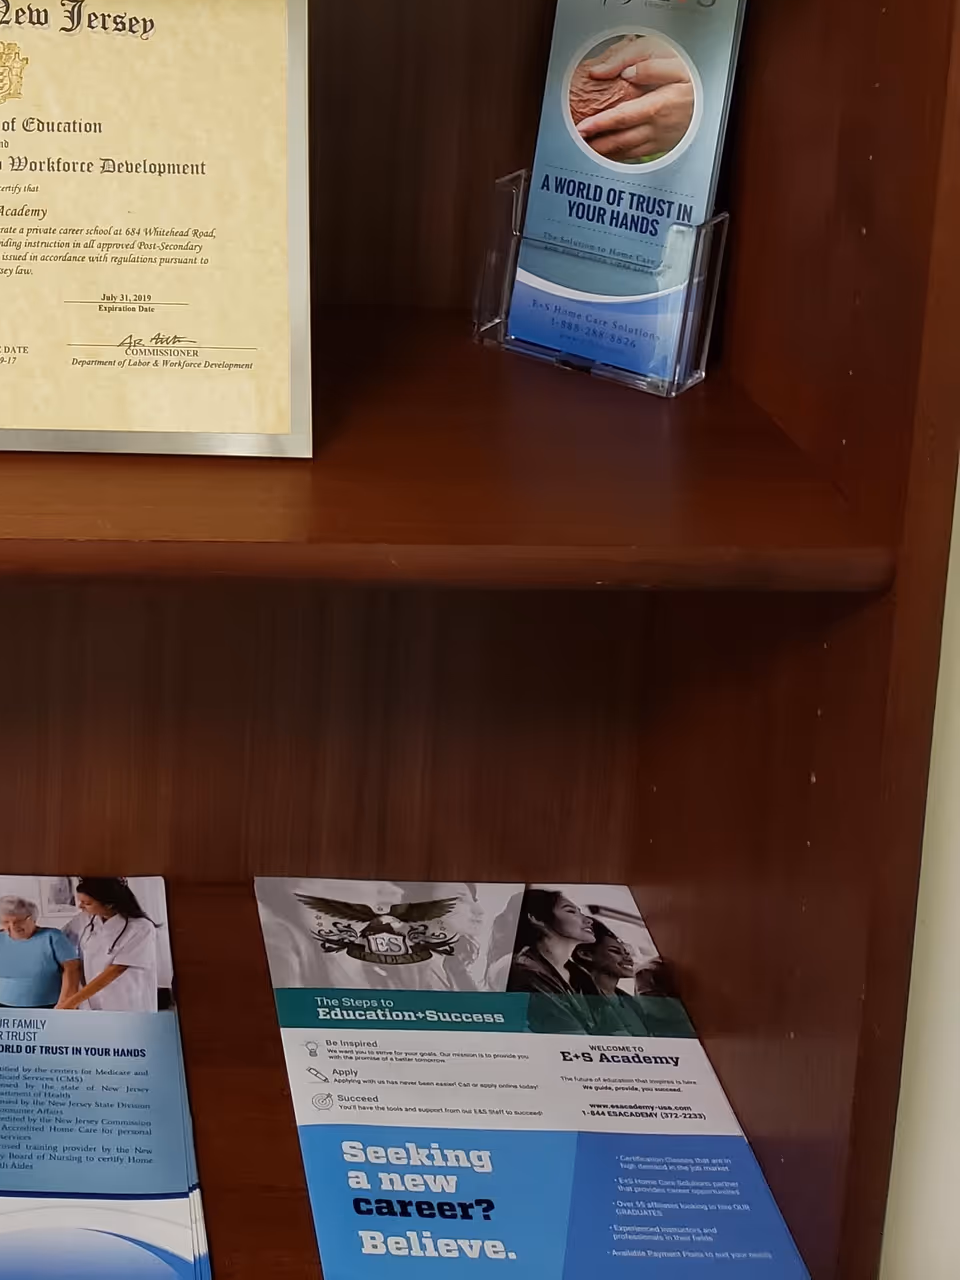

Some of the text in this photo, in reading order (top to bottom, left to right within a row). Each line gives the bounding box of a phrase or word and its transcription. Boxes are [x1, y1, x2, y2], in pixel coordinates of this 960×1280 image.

[1, 116, 16, 131] of
[21, 116, 102, 133] Education
[7, 155, 93, 172] Workforce
[98, 157, 205, 177] Development
[540, 172, 694, 224] A WORLD OF TRUST IN
[567, 199, 660, 237] YOUR HANDS
[101, 293, 152, 303] July 31, 2019
[3, 345, 28, 354] DATE
[314, 996, 394, 1011] The Steps to
[316, 1007, 505, 1024] Education+Success
[12, 1018, 47, 1031] FAMILY
[4, 1031, 38, 1042] TRUST
[560, 1050, 681, 1067] E+S Academy
[341, 1140, 493, 1173] Seeking
[347, 1171, 458, 1194] a new
[352, 1196, 496, 1220] career?
[358, 1230, 517, 1261] Believe.
